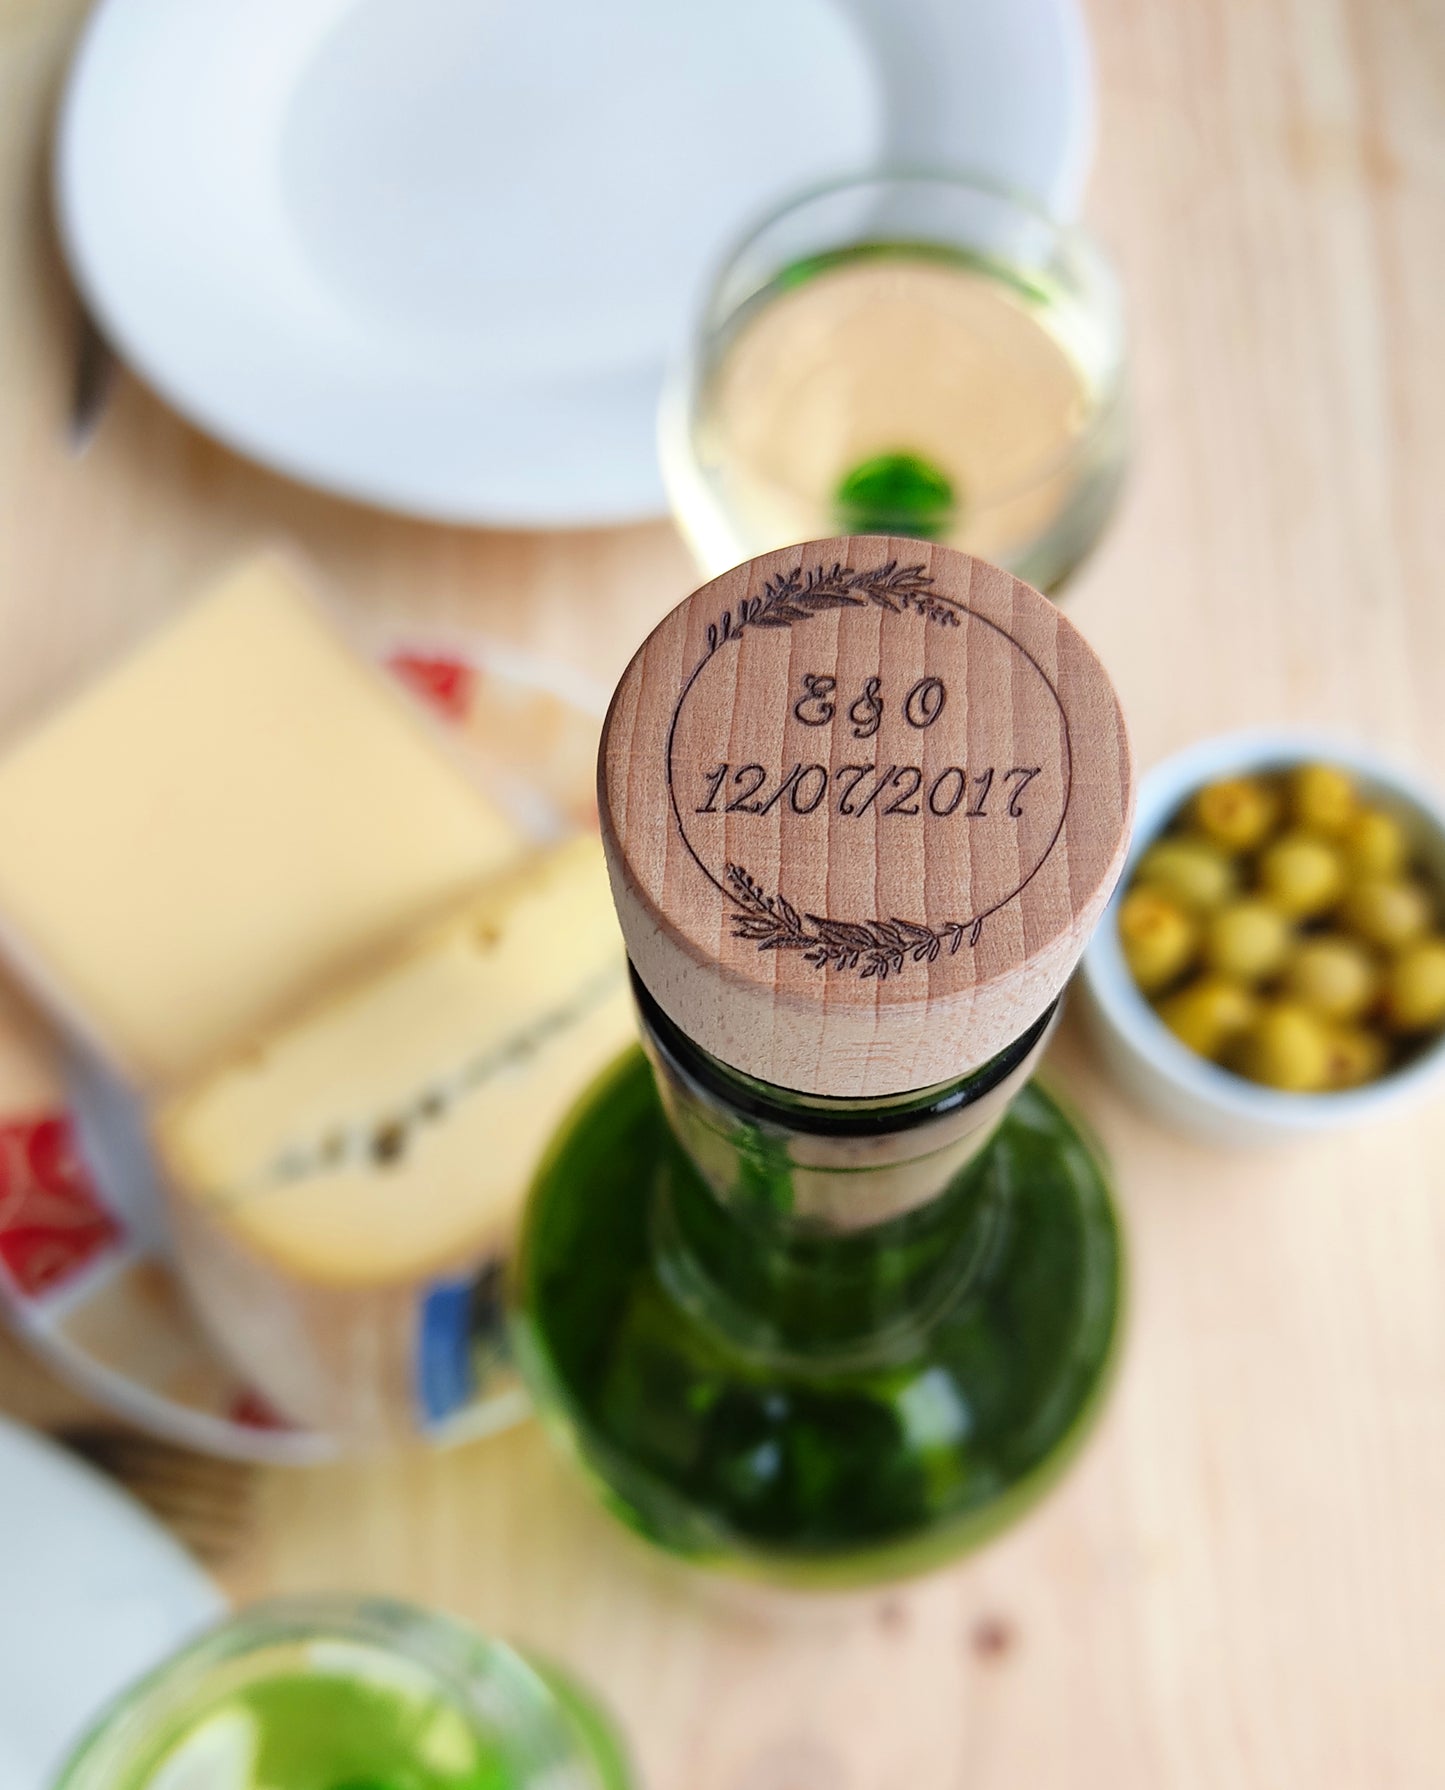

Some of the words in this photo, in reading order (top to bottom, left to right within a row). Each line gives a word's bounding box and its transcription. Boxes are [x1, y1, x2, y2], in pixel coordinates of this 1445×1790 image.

[793, 673, 837, 728] E
[849, 676, 884, 739] &
[904, 675, 946, 729] O
[695, 762, 1042, 818] 12/07/2017
